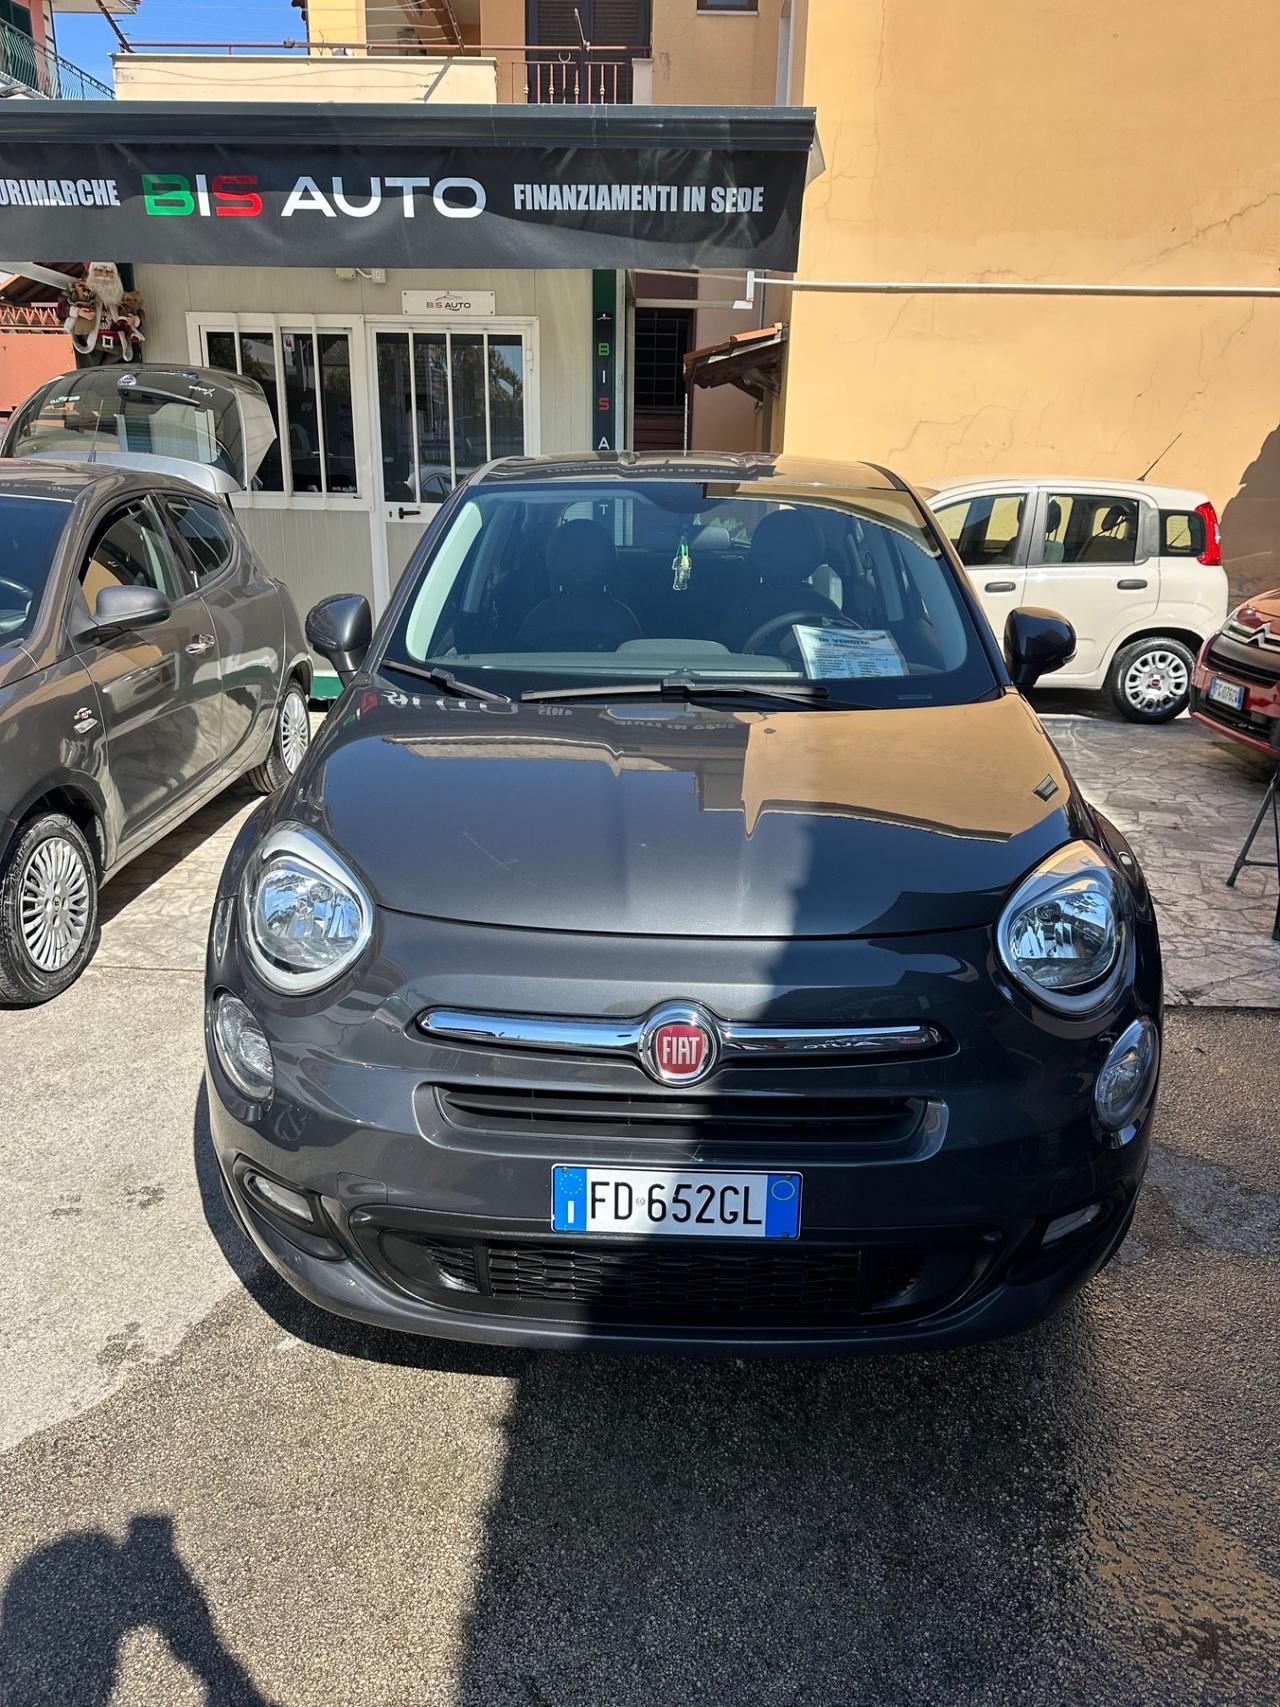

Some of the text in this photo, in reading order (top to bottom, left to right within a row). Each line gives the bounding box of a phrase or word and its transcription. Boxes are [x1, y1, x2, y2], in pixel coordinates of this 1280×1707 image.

[141, 174, 487, 218] BIS AUTO
[513, 183, 765, 213] FINANZIAMENTI IN SEDE
[662, 1035, 700, 1065] FIAT
